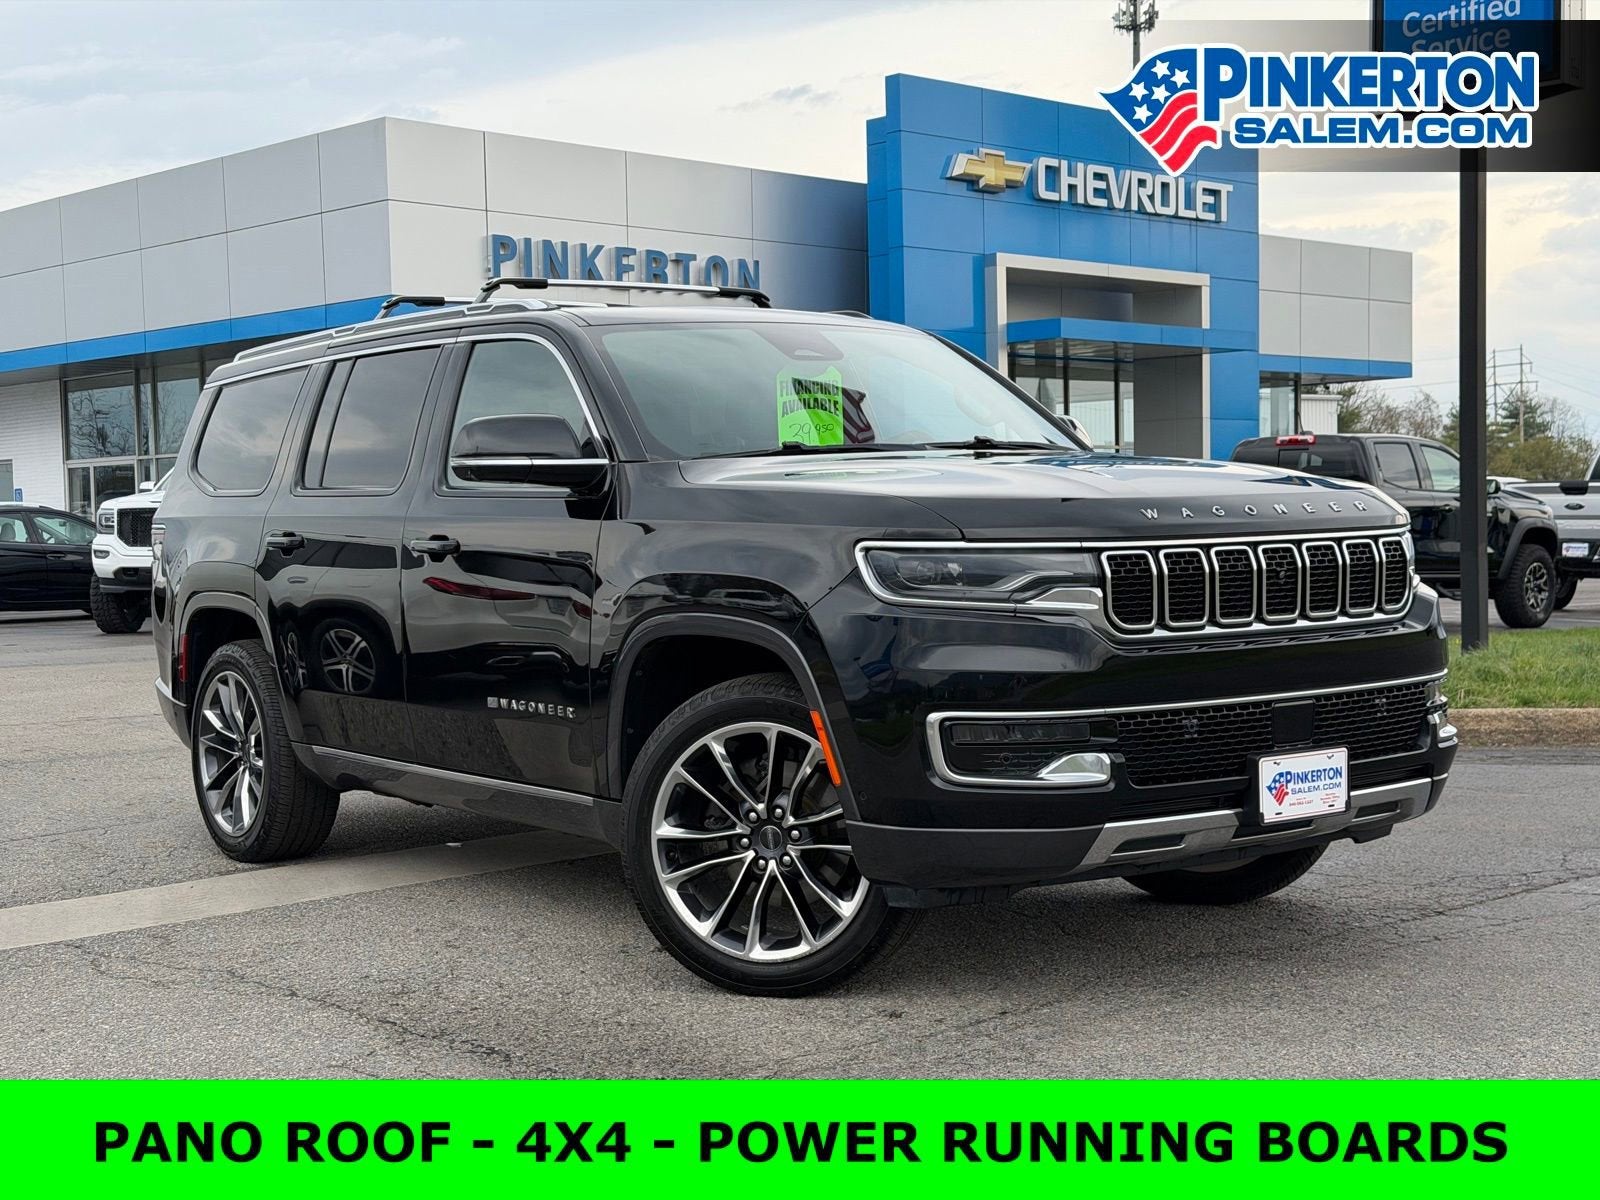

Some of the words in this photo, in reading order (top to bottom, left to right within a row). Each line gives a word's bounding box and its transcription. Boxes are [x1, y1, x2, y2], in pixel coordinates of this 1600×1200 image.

[1402, 0, 1521, 38] Certified
[1034, 156, 1234, 223] CHEVROLET
[488, 233, 761, 290] PINKERTON
[781, 397, 841, 418] AVAILABLE
[1139, 500, 1369, 521] WAGONEER
[500, 697, 577, 719] WAGONEER
[1285, 766, 1343, 790] PINKERTON
[1290, 781, 1342, 795] SALEM.COM
